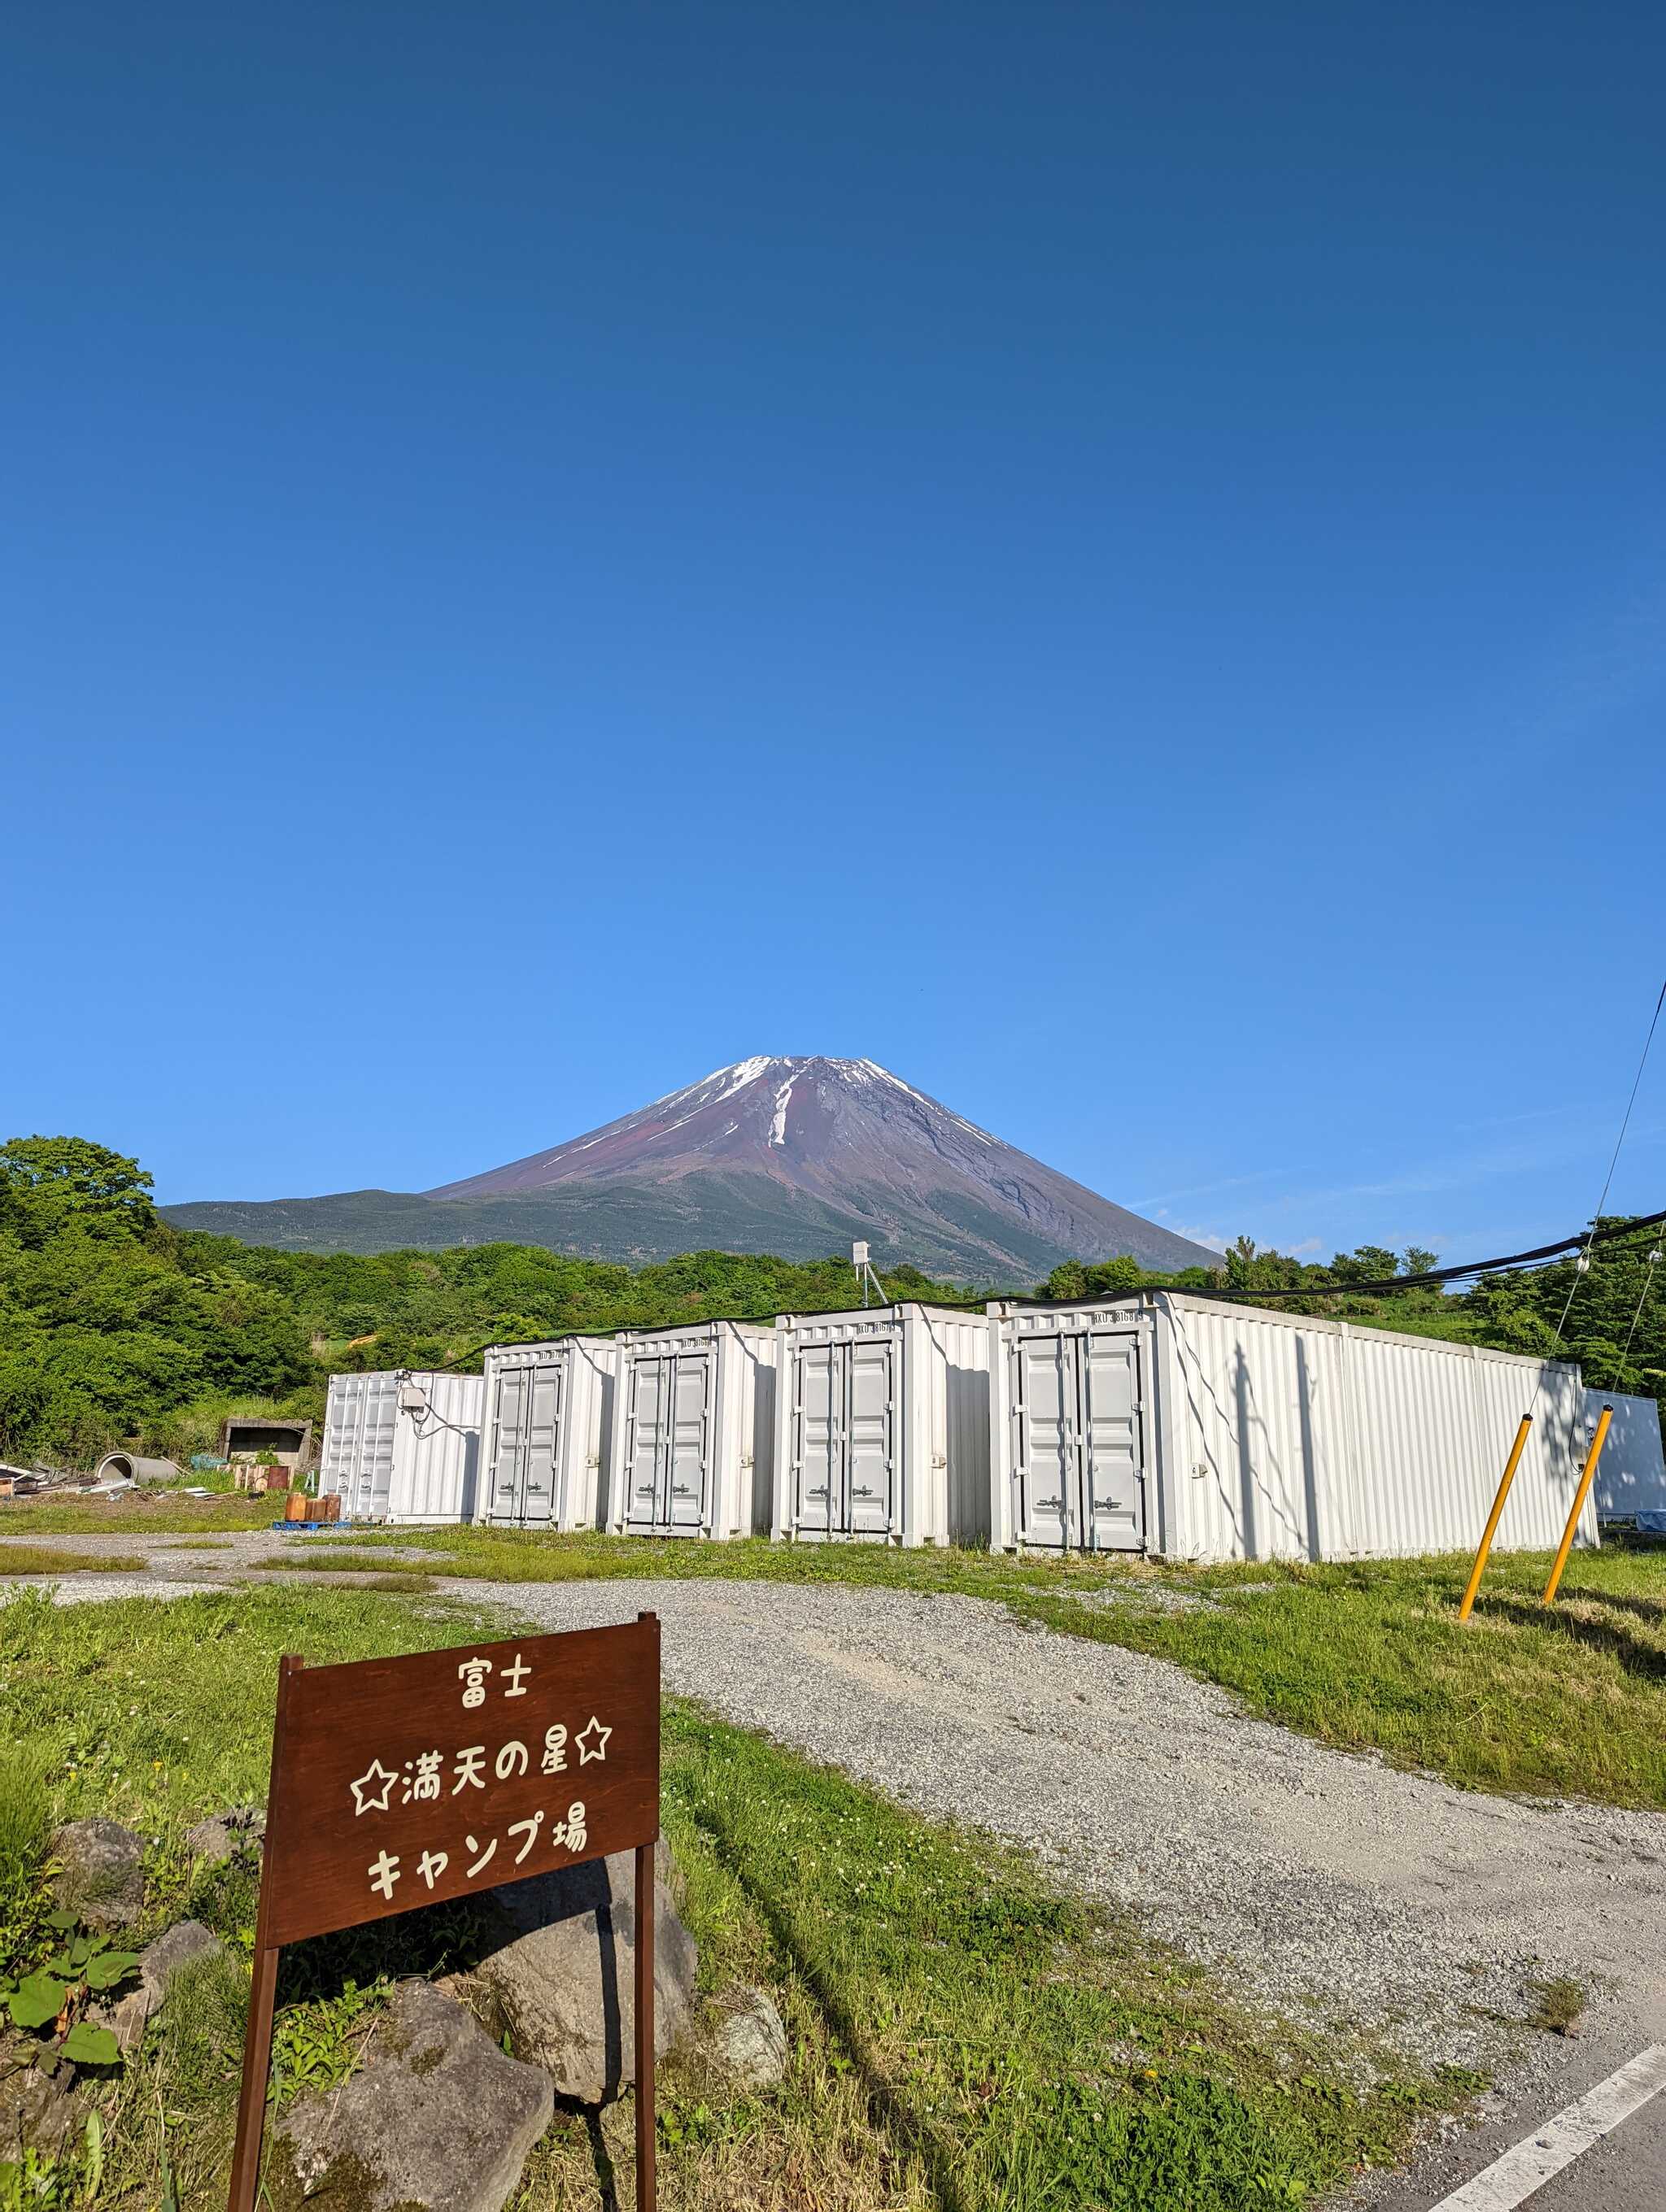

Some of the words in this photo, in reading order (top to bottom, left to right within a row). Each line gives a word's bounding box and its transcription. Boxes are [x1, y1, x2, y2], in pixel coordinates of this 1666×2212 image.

[458, 1653, 533, 1709] 富士
[368, 1801, 587, 1900] キャンプ場
